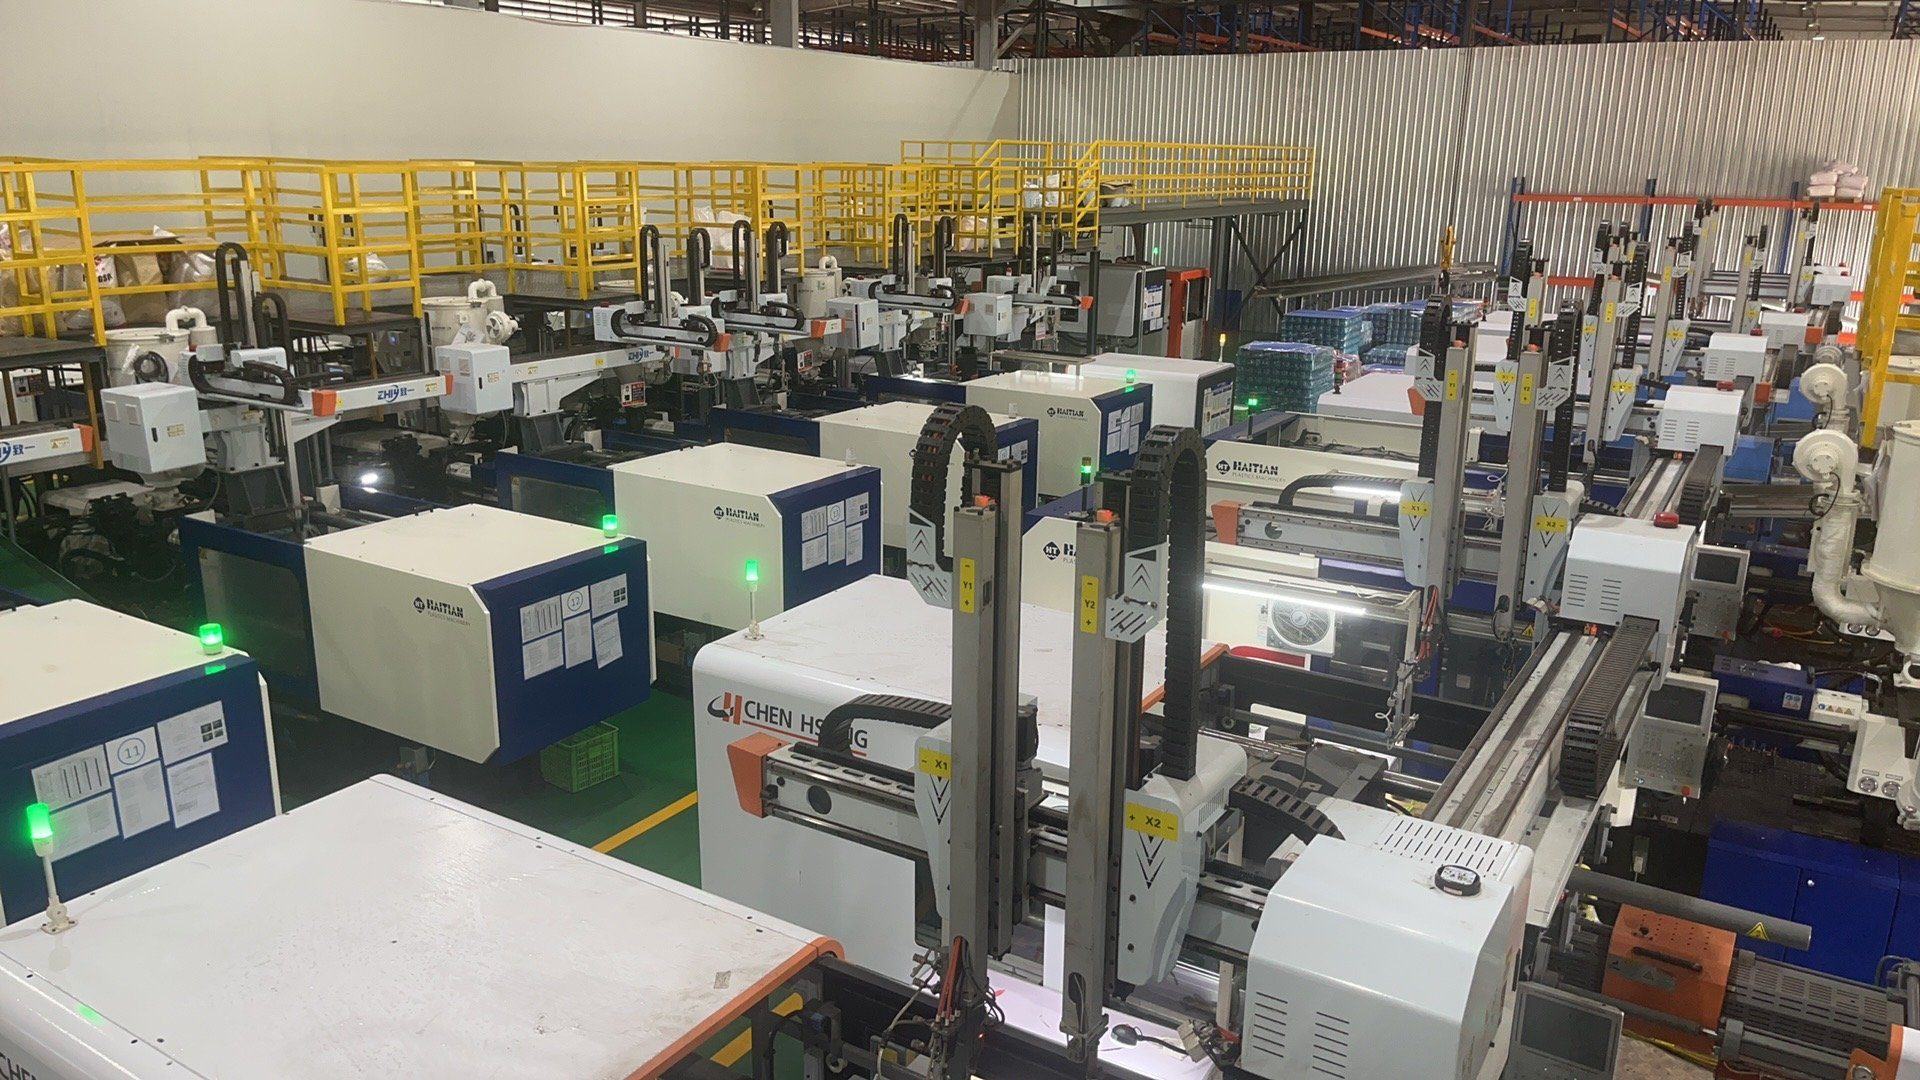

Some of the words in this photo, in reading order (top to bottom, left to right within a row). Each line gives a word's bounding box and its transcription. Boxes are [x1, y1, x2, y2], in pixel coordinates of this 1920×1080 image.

[1056, 407, 1084, 418] HAITIAN
[1232, 461, 1279, 475] HAITIAN
[726, 507, 759, 522] HAITIAN
[963, 581, 973, 590] Y1
[426, 598, 464, 619] HAITIAN
[1084, 599, 1095, 609] Y2
[744, 700, 792, 728] CHEN
[801, 714, 868, 749] HSG
[124, 745, 141, 759] 11
[935, 759, 948, 770] X1
[1145, 815, 1161, 829] X2
